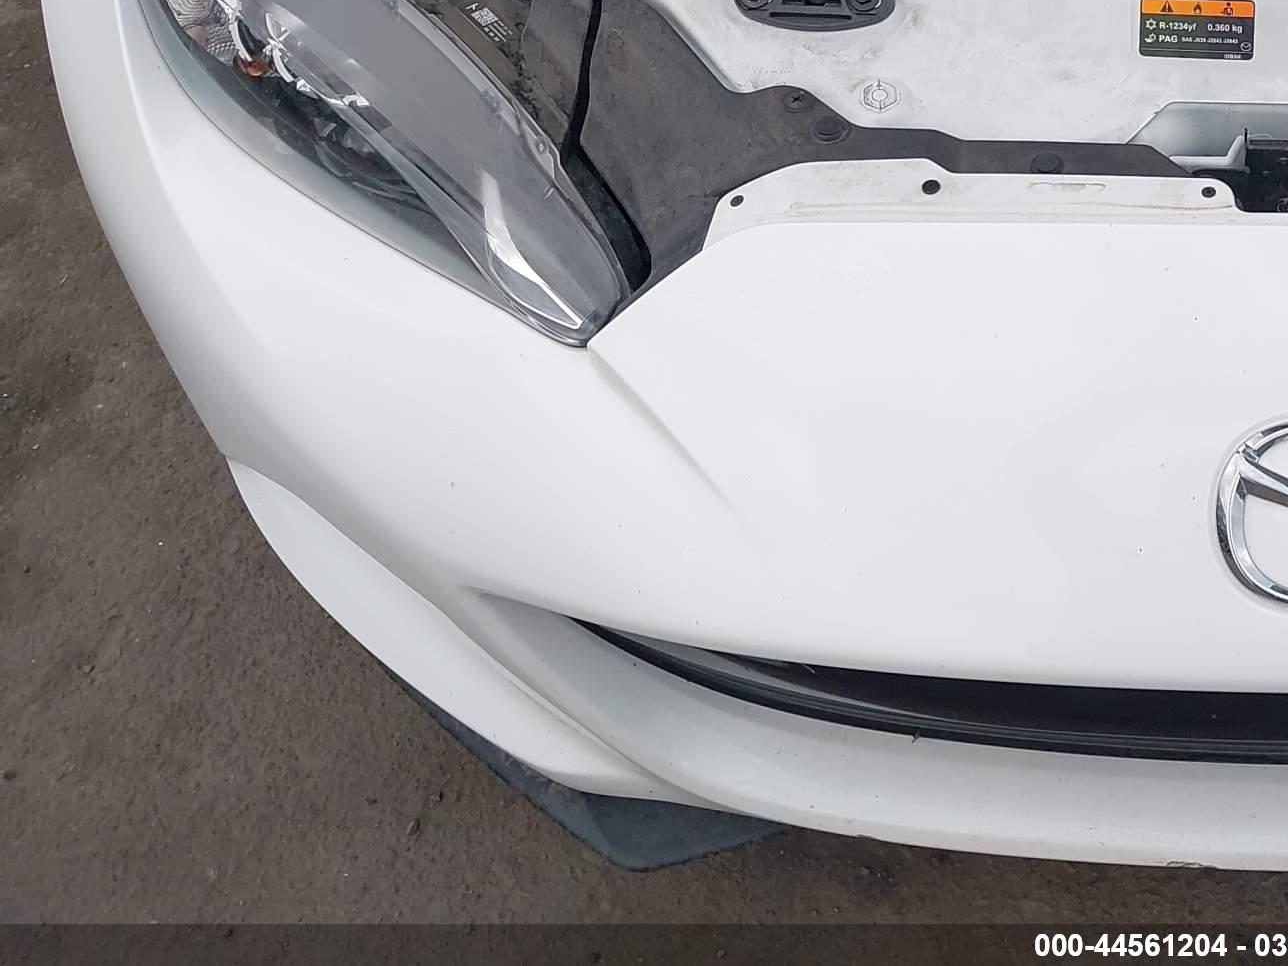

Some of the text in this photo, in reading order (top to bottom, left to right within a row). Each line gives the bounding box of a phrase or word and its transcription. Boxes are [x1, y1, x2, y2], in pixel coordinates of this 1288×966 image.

[1159, 22, 1243, 34] R-1234yf 0.360 kg
[1158, 35, 1178, 43] PAG
